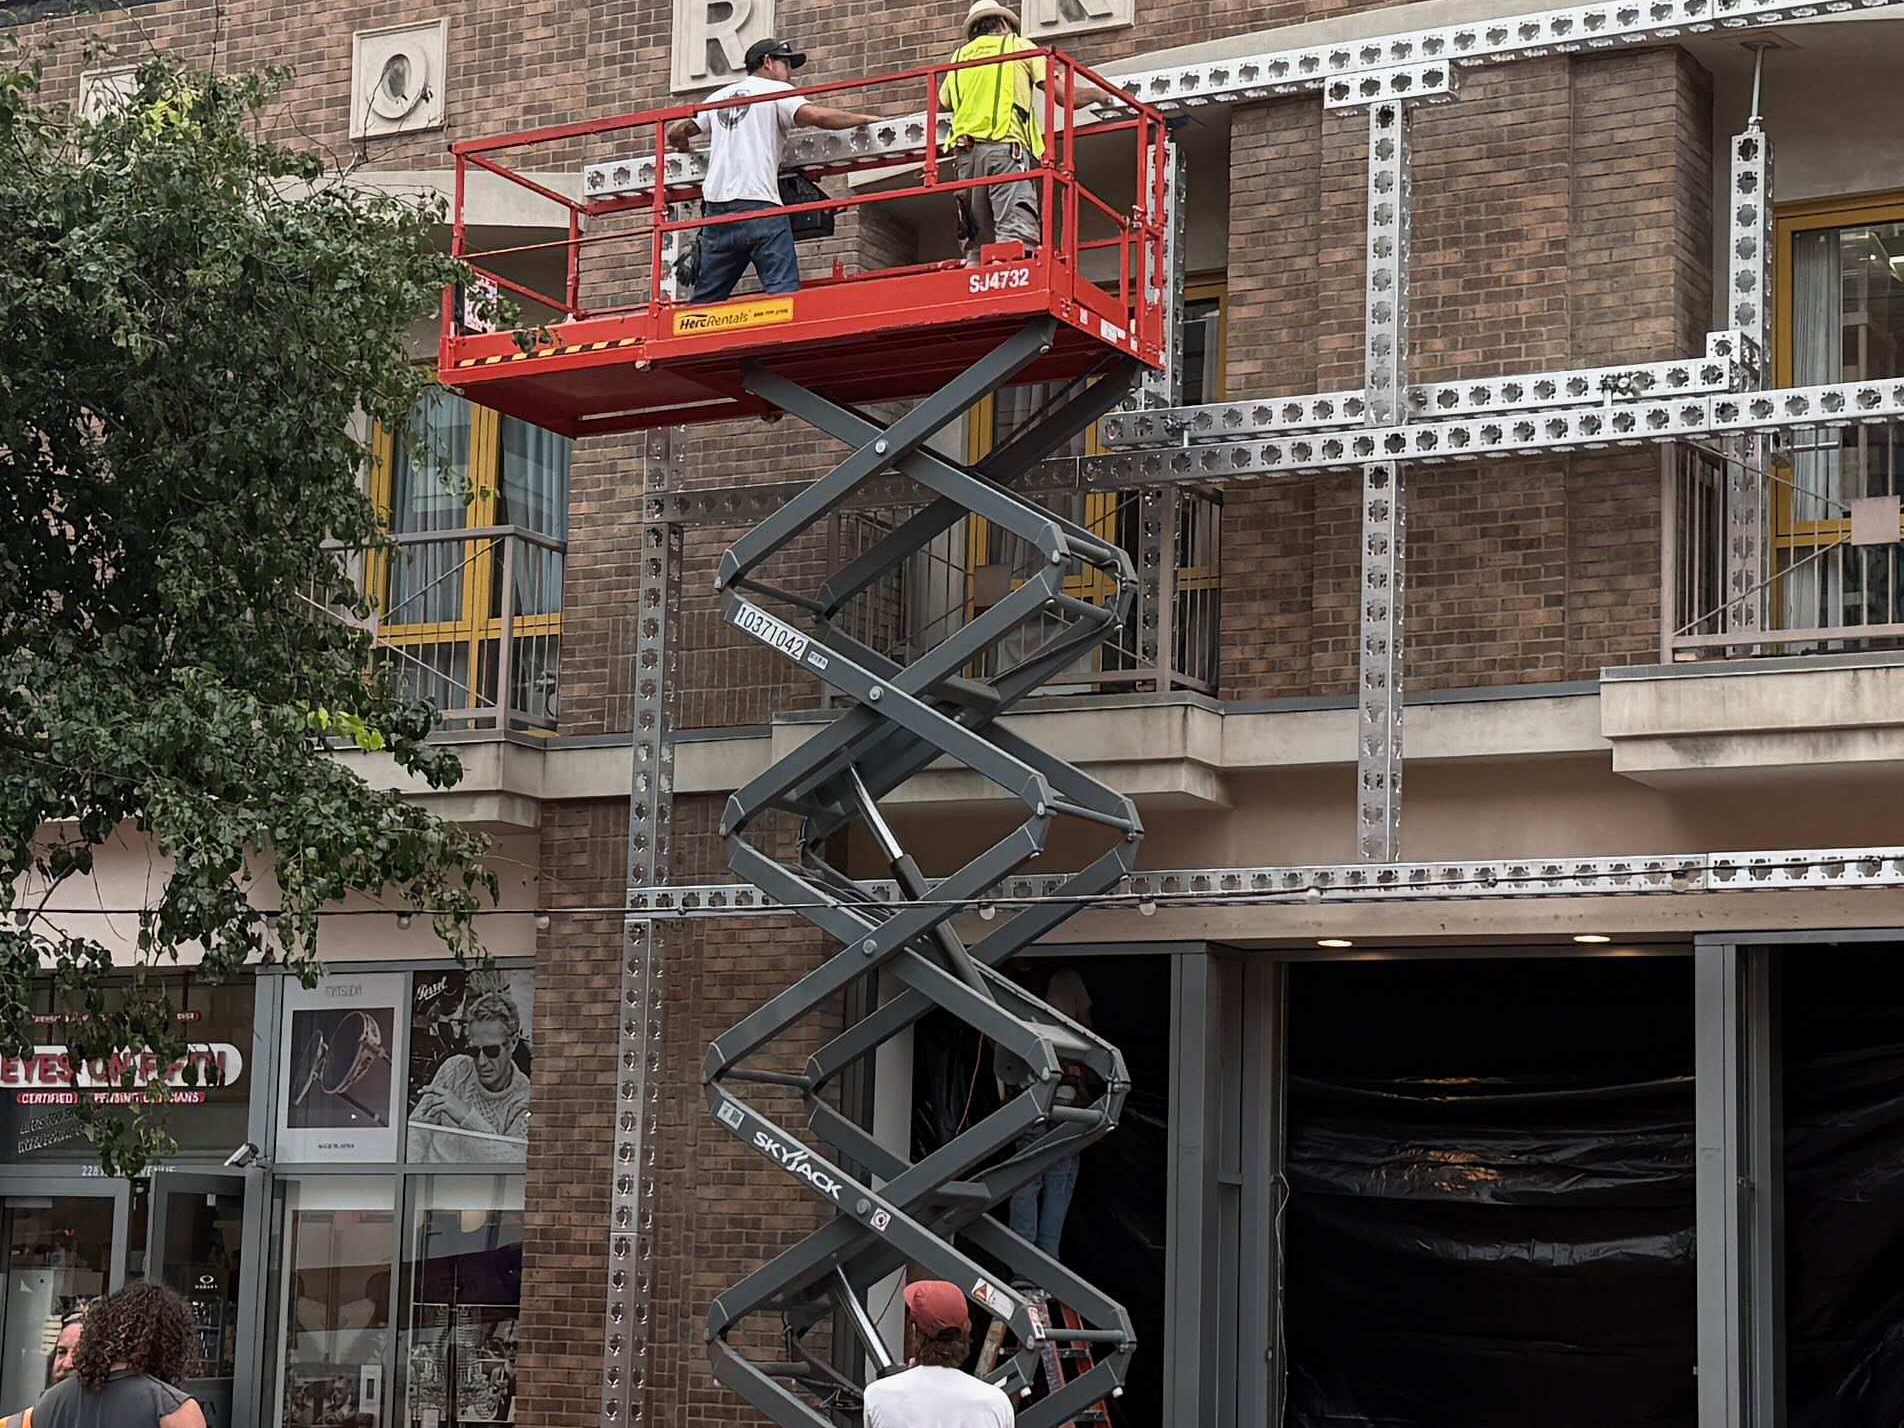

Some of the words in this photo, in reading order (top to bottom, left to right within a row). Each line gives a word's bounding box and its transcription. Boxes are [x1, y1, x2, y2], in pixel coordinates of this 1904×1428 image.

[969, 268, 1030, 294] SJ4732
[737, 606, 805, 659] 10371042
[0, 1053, 73, 1084] EYES
[752, 1131, 843, 1201] SKYJACK
